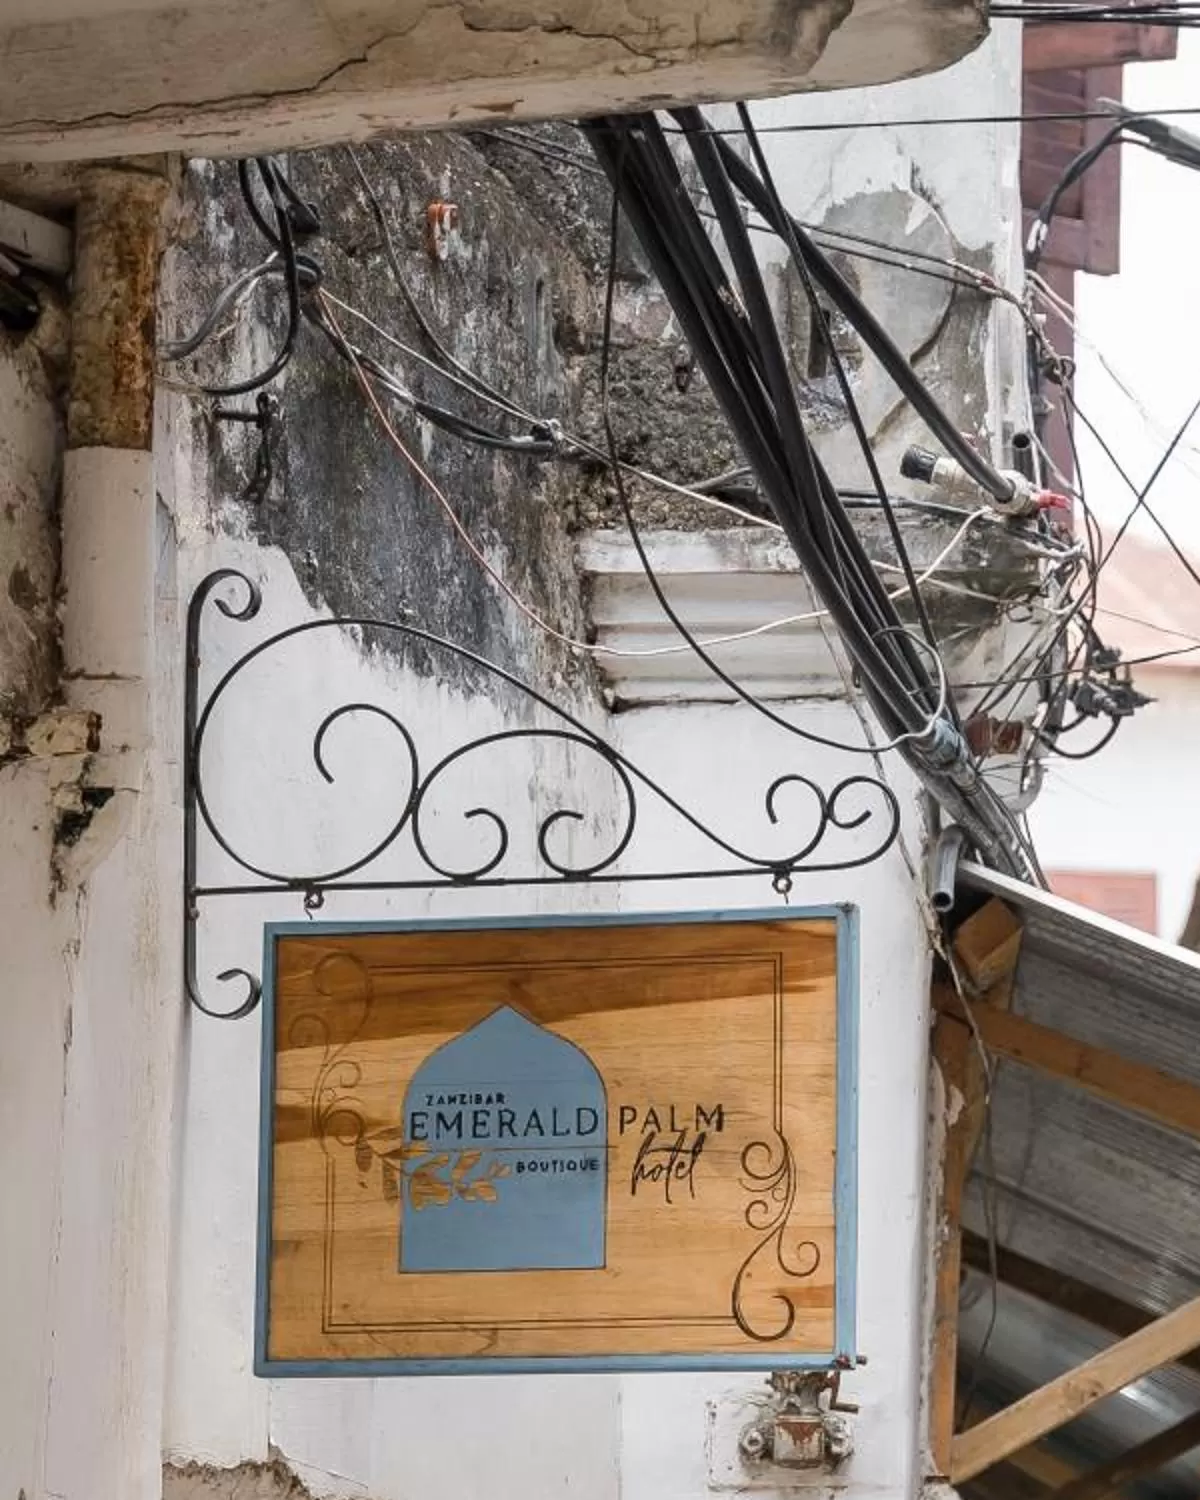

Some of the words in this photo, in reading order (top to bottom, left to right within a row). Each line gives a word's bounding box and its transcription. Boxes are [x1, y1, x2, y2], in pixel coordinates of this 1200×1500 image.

[425, 1092, 506, 1106] ZANZIBAR
[409, 1108, 600, 1141] EMERALD
[618, 1104, 726, 1136] PALM
[516, 1158, 601, 1174] BOUTIQUE
[630, 1131, 708, 1204] hotel
